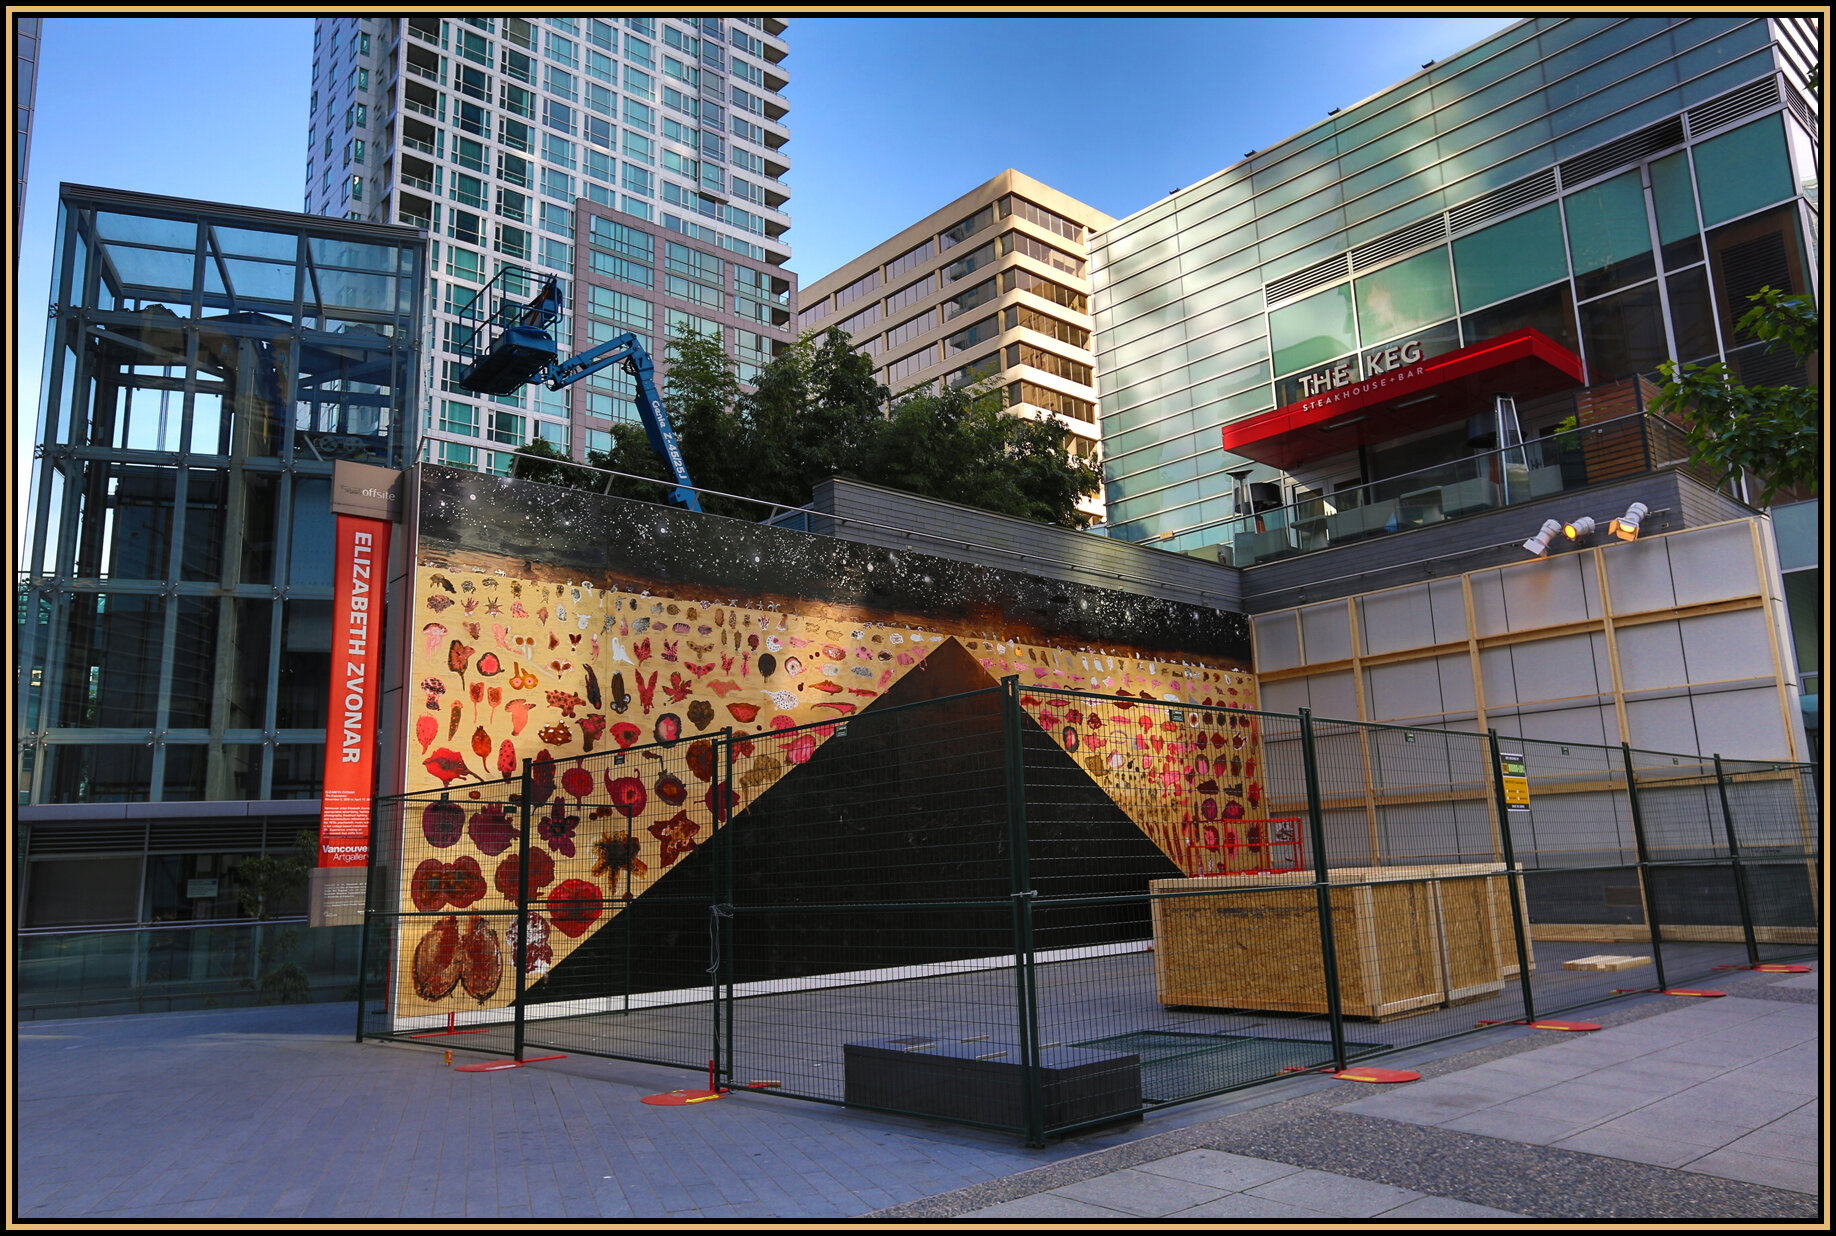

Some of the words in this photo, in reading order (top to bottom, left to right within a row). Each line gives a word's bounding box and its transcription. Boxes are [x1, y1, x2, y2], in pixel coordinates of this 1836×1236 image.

[1298, 363, 1350, 398] THE
[1366, 340, 1423, 377] KEG
[663, 432, 688, 480] Z-45/25J
[362, 487, 396, 501] offsite
[348, 531, 372, 655] ELIZABETH
[342, 662, 365, 763] ZVONAR
[322, 845, 368, 853] Vancouve
